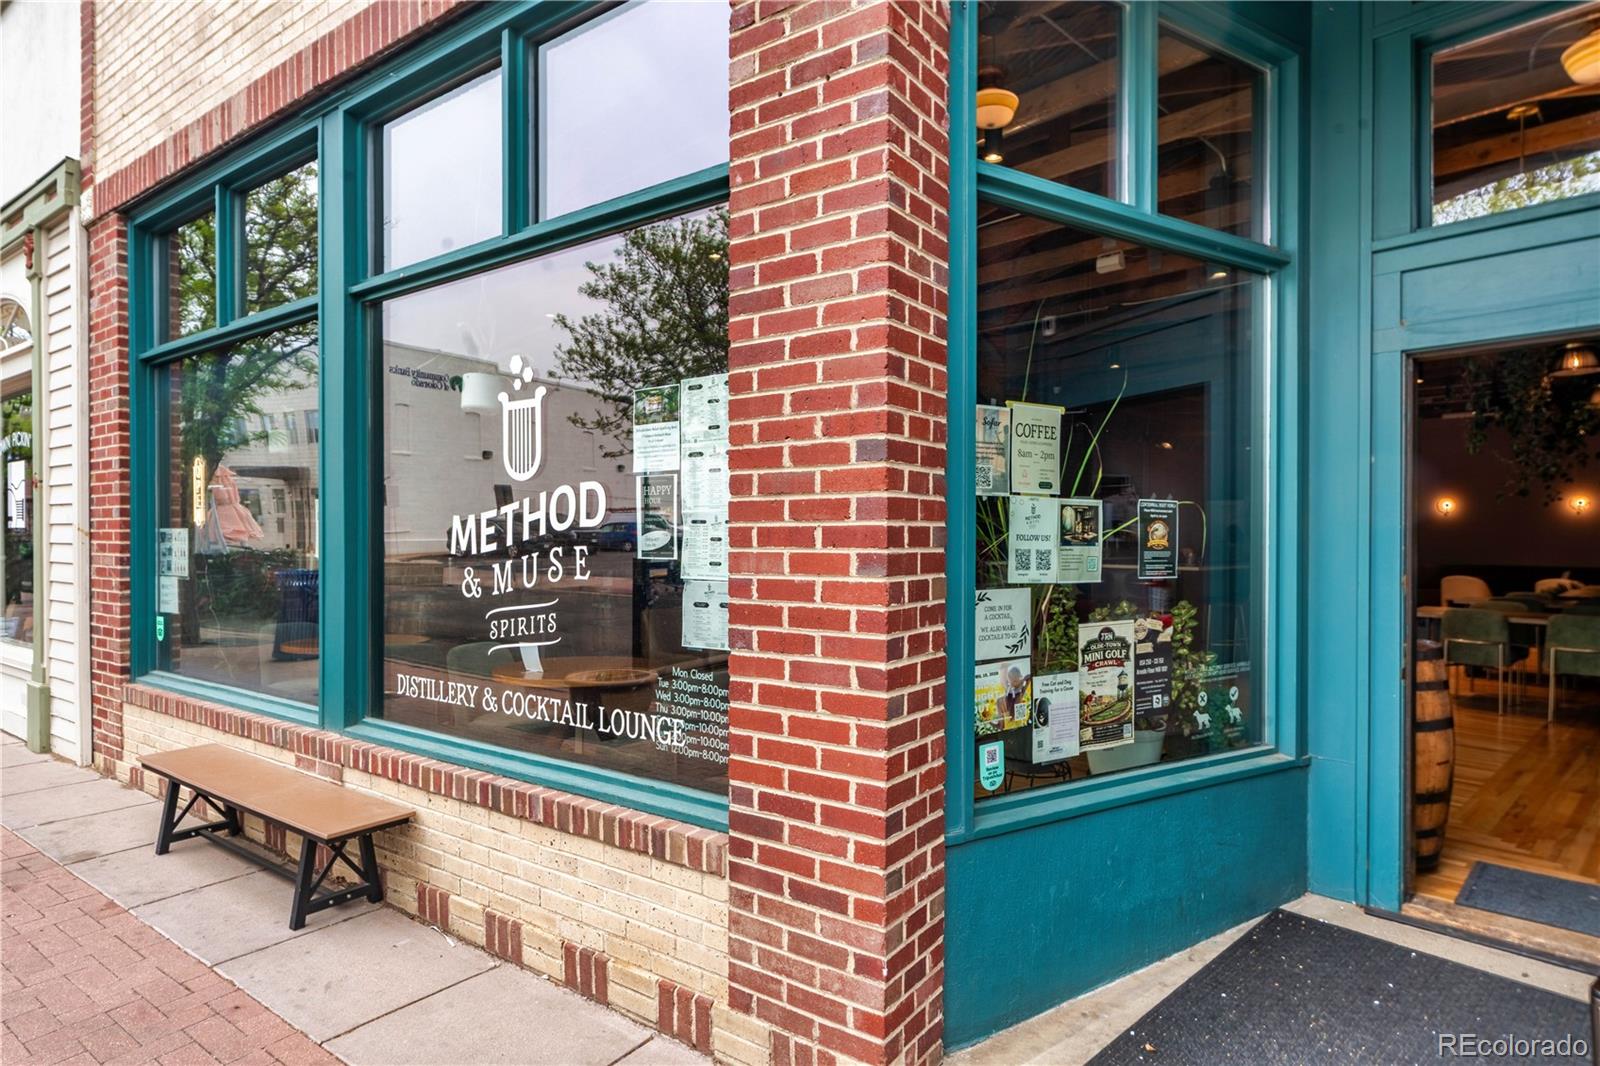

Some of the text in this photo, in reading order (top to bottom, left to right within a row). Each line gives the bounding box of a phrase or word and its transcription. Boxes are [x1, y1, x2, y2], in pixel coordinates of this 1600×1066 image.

[1015, 422, 1057, 441] COFFEE
[1017, 449, 1033, 459] 8am
[1040, 450, 1055, 461] 2pm
[643, 485, 672, 496] HAPPY
[450, 480, 607, 556] METHOD
[1016, 534, 1040, 542] FOLLOW
[461, 545, 591, 599] & MUSE
[489, 612, 557, 640] SPIRITS
[1084, 649, 1127, 663] MINI GOLF
[672, 666, 714, 681] Mon Closed
[657, 677, 669, 688] Tue
[655, 689, 671, 701] Wed
[397, 673, 686, 747] DISTILLERY & COCKTAIL LOUNGE
[656, 702, 669, 713] Thu
[656, 740, 668, 752] Sun
